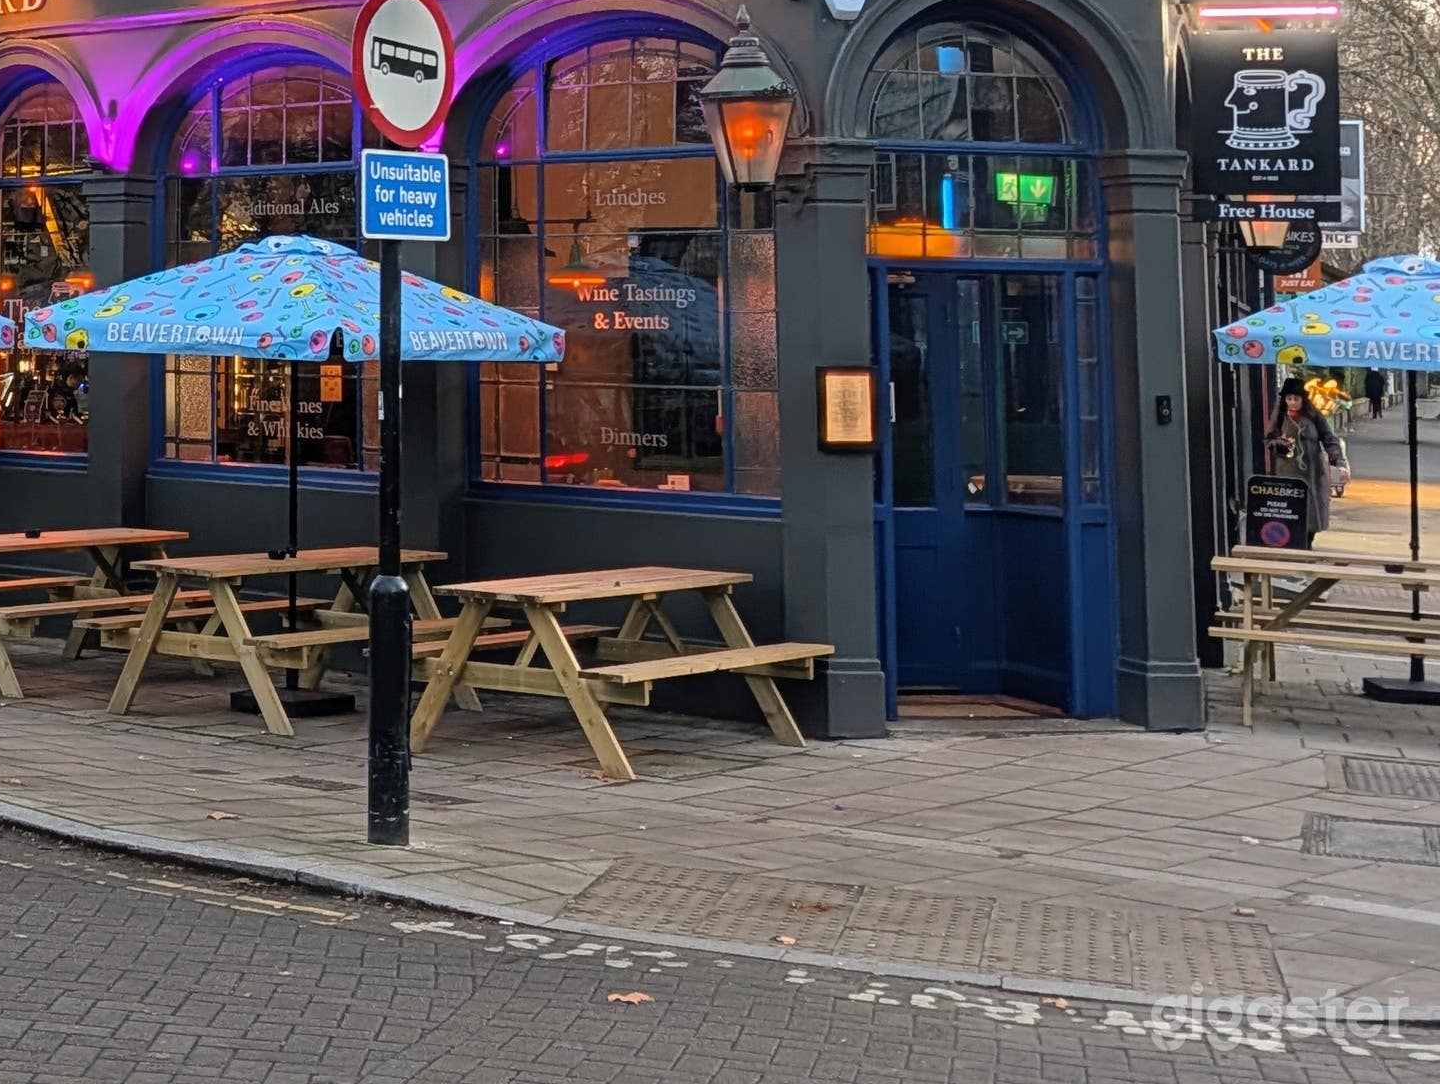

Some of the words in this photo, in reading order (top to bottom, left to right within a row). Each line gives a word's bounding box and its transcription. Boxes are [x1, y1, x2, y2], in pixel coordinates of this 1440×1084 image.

[1242, 47, 1284, 61] THE
[370, 161, 442, 183] Unsuitable
[1217, 158, 1315, 171] TANKARD
[233, 198, 305, 215] Traditional
[308, 198, 340, 214] Ales
[374, 184, 395, 203] for
[399, 185, 437, 209] heavy
[594, 188, 666, 206] Lunches
[378, 208, 434, 228] vehicles
[1218, 204, 1256, 218] Free
[1260, 204, 1316, 219] House
[577, 285, 620, 302] Wine
[623, 284, 696, 309] Tastings
[3, 299, 41, 323] Th
[594, 312, 610, 330] &
[613, 311, 670, 330] Events
[106, 322, 246, 345] BEAVERTOWN
[410, 330, 508, 351] BEAVERTOWN
[249, 395, 275, 412] Fine
[280, 397, 323, 414] Wnes
[247, 420, 260, 436] &
[262, 419, 324, 439] Whikies
[600, 427, 668, 447] Dinners
[1250, 485, 1305, 498] CHASBIKES
